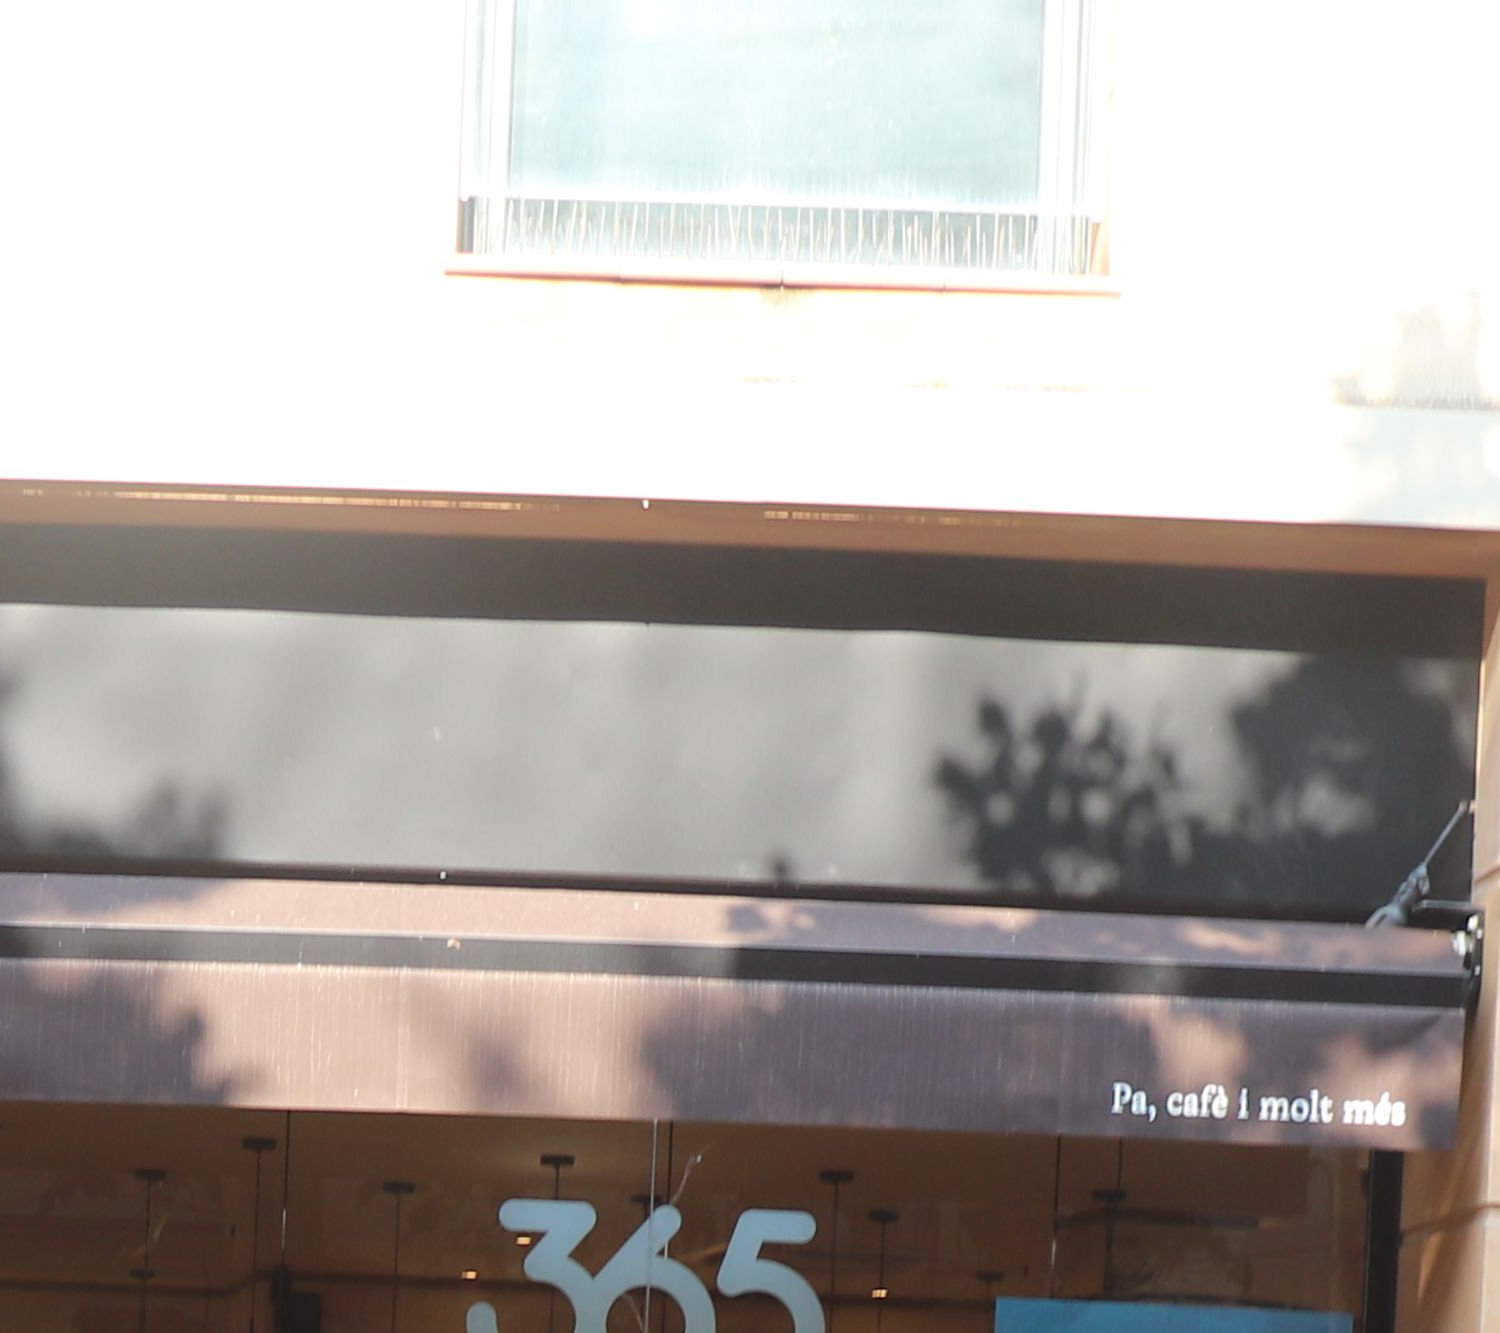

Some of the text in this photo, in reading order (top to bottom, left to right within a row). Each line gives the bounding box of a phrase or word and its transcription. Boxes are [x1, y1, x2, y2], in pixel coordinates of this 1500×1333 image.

[1110, 1082, 1158, 1123] Pa,
[1237, 1087, 1249, 1120] i
[1258, 1088, 1333, 1124] molt
[1341, 1091, 1407, 1127] més
